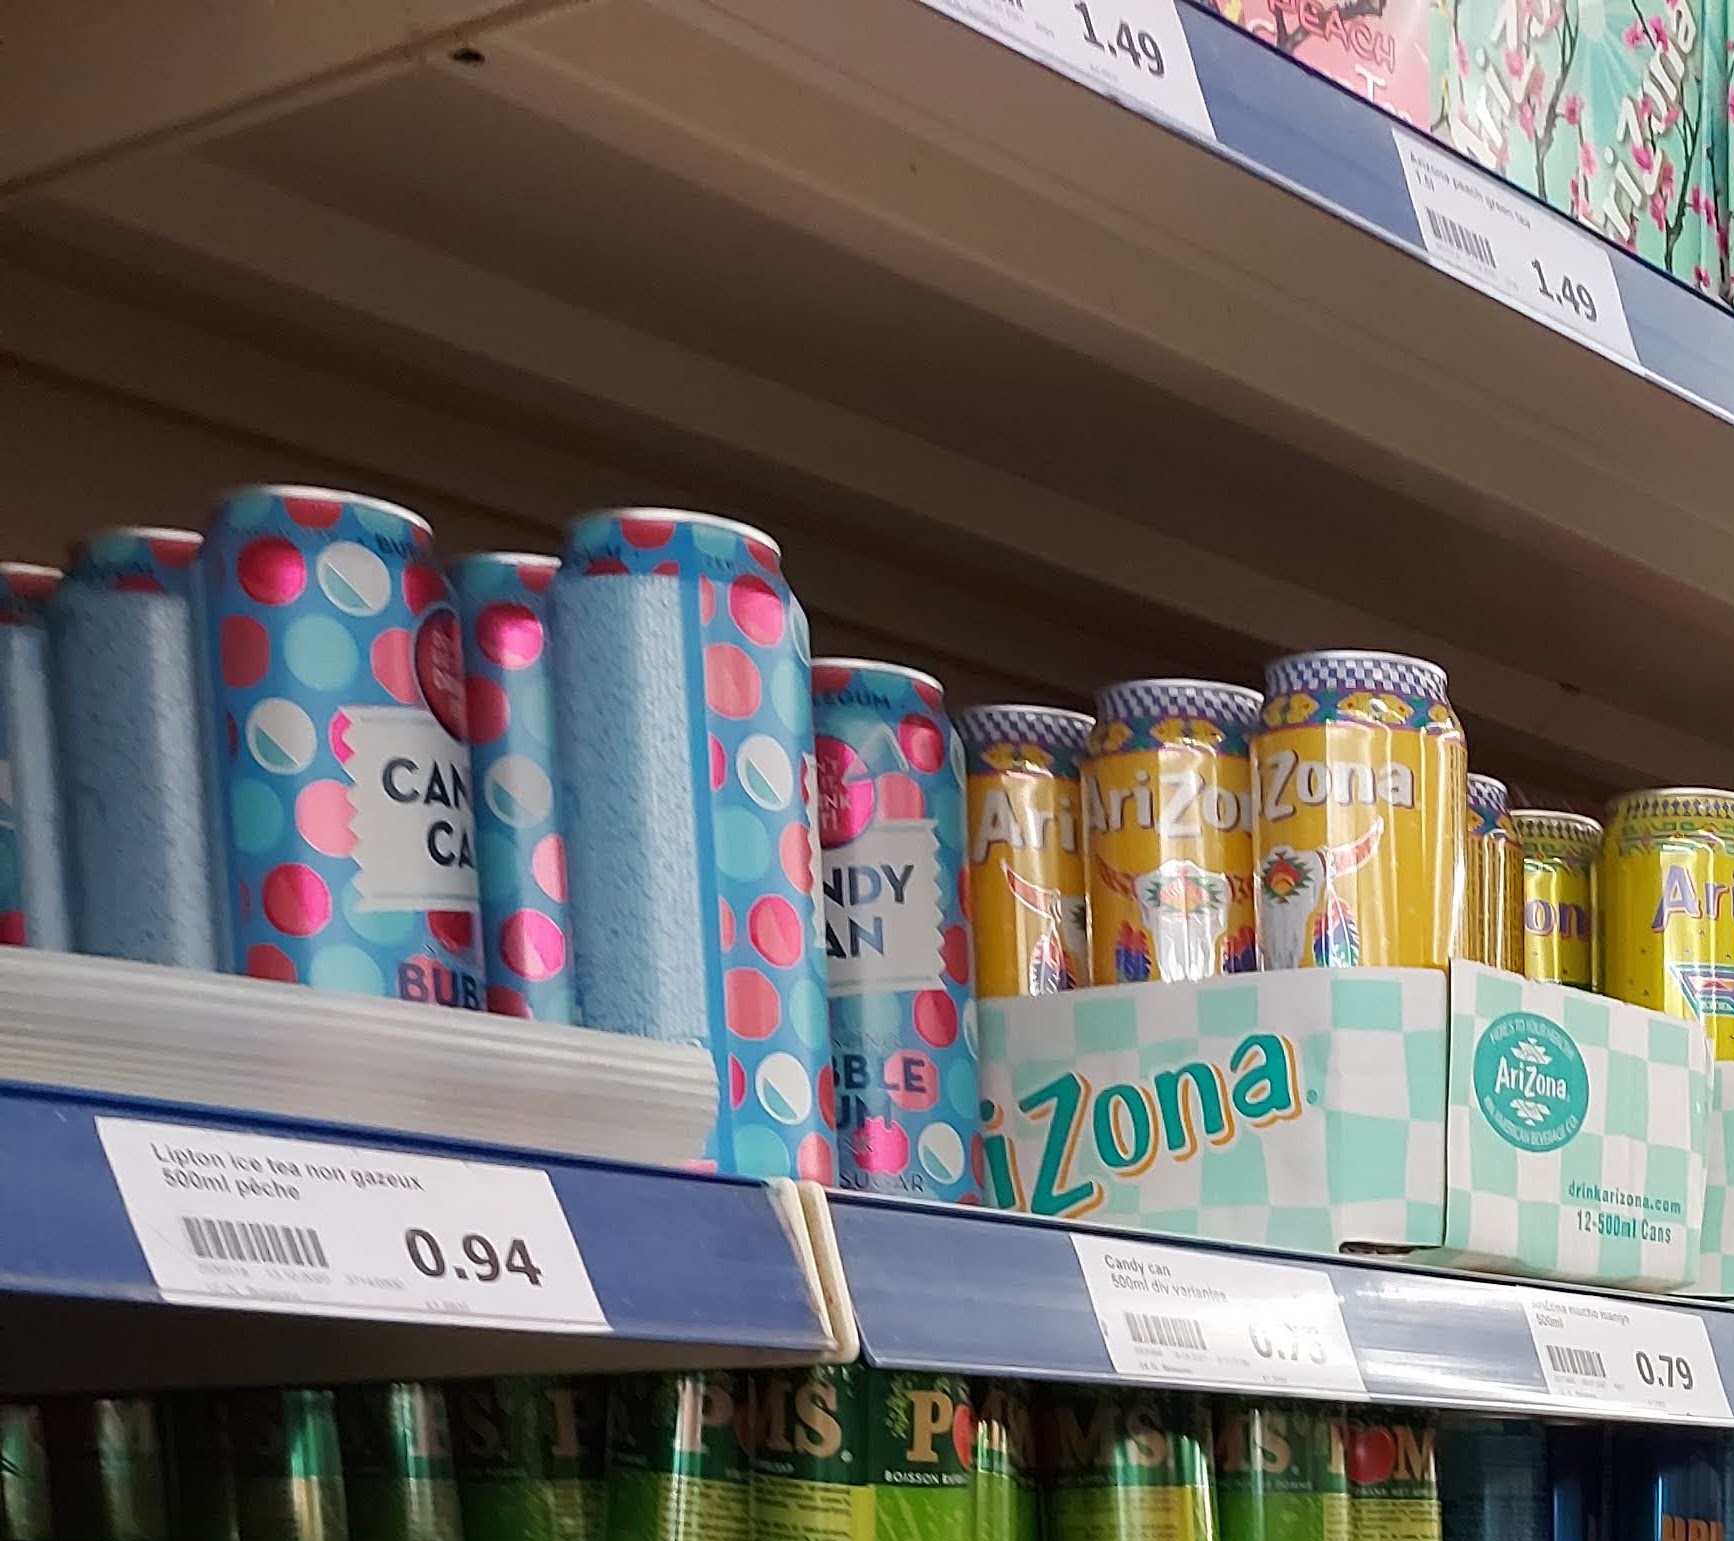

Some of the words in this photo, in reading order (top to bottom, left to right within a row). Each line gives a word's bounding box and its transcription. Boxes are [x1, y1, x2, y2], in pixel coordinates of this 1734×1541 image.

[1079, 0, 1166, 78] 1.49
[1530, 257, 1599, 322] 1.49
[1495, 1056, 1567, 1099] AriZona
[150, 1143, 226, 1171] Lipton
[229, 1152, 263, 1174] ice
[267, 1157, 302, 1178] tea
[306, 1163, 347, 1184] non
[351, 1168, 426, 1193] gazeux
[162, 1169, 231, 1196] 500ml
[236, 1177, 301, 1202] pêche
[1568, 1180, 1682, 1214] drinkarizona.com
[1577, 1209, 1637, 1239] 12-500ml
[1641, 1220, 1672, 1244] Cans
[405, 1227, 544, 1288] 0.94
[1105, 1254, 1145, 1276] Candy
[1149, 1263, 1171, 1278] can
[1635, 1350, 1694, 1390] 0.79
